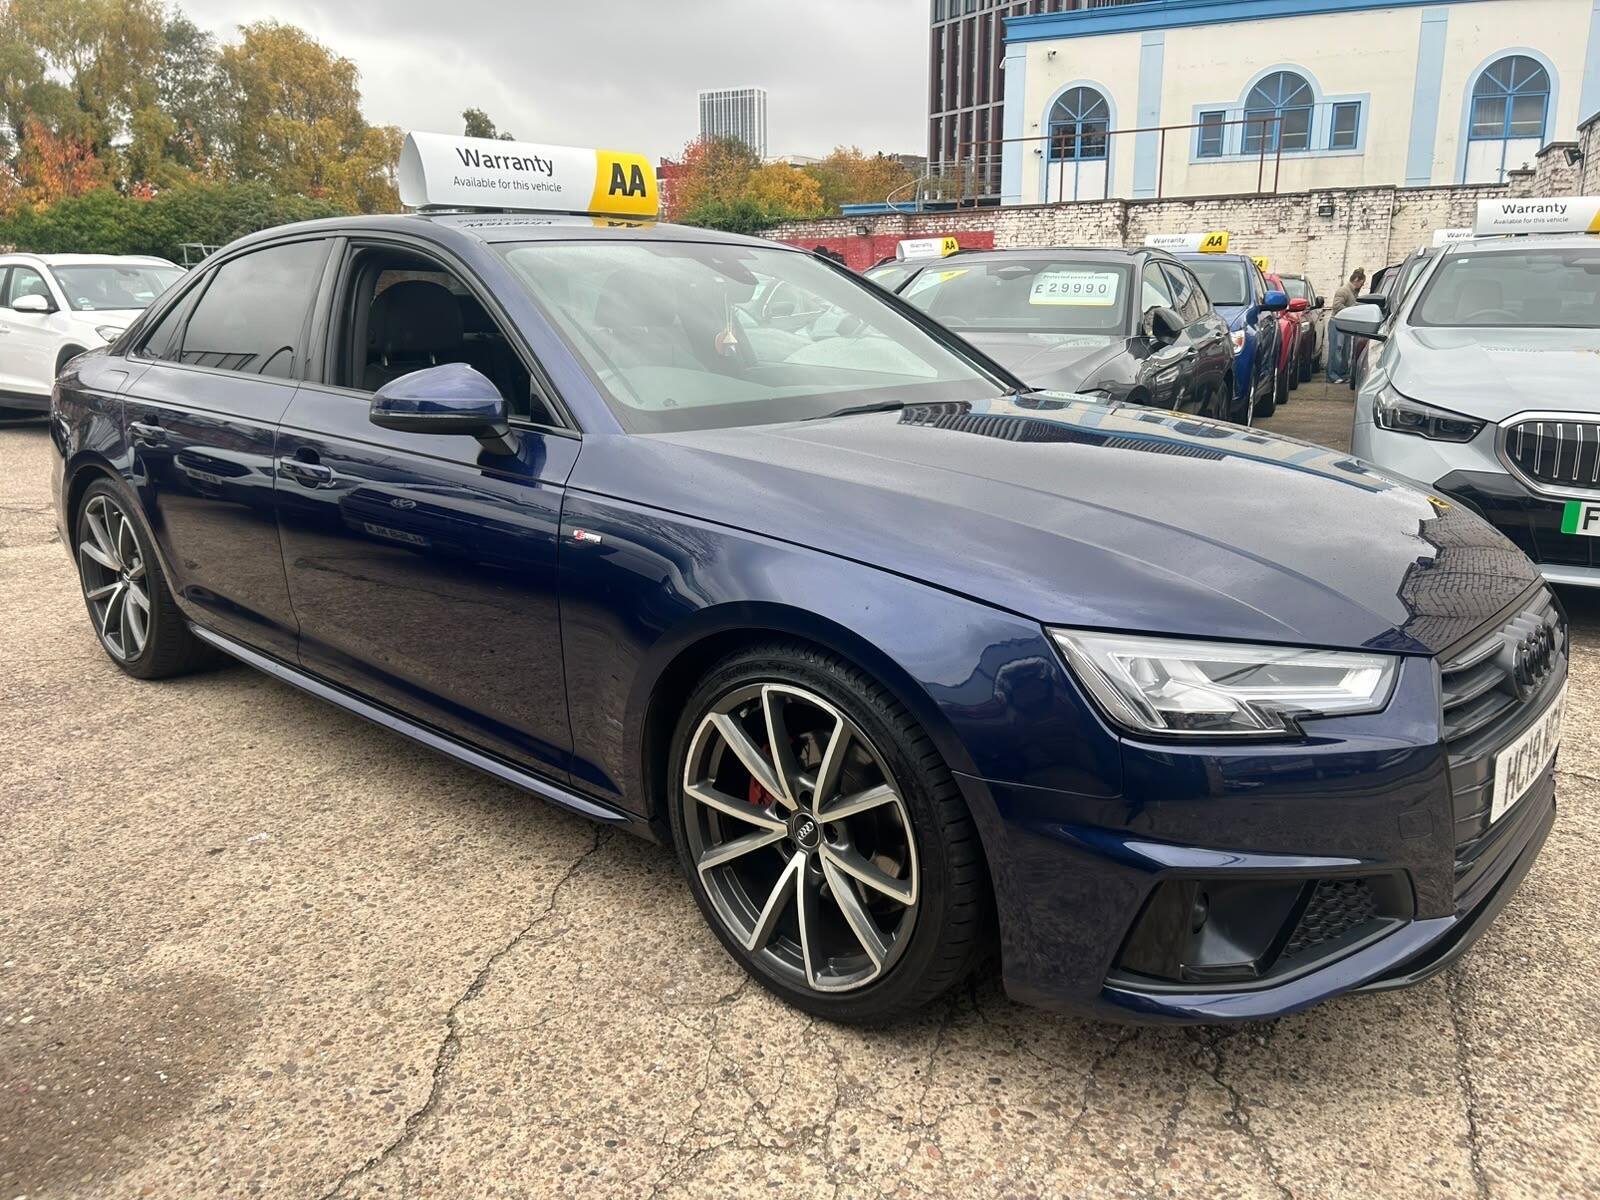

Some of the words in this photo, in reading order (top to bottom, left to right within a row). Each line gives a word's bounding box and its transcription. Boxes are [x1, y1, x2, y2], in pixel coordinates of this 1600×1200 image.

[456, 147, 553, 177] Warranty
[453, 176, 496, 188] Available
[498, 179, 511, 189] for
[512, 181, 530, 190] this
[531, 183, 562, 192] vehicle
[608, 162, 647, 197] AA
[1501, 203, 1567, 215] Warranty
[1533, 216, 1545, 224] this
[1546, 216, 1569, 224] vehicle
[945, 240, 956, 250] AA
[1206, 235, 1223, 247] AA
[1049, 282, 1107, 294] 29990
